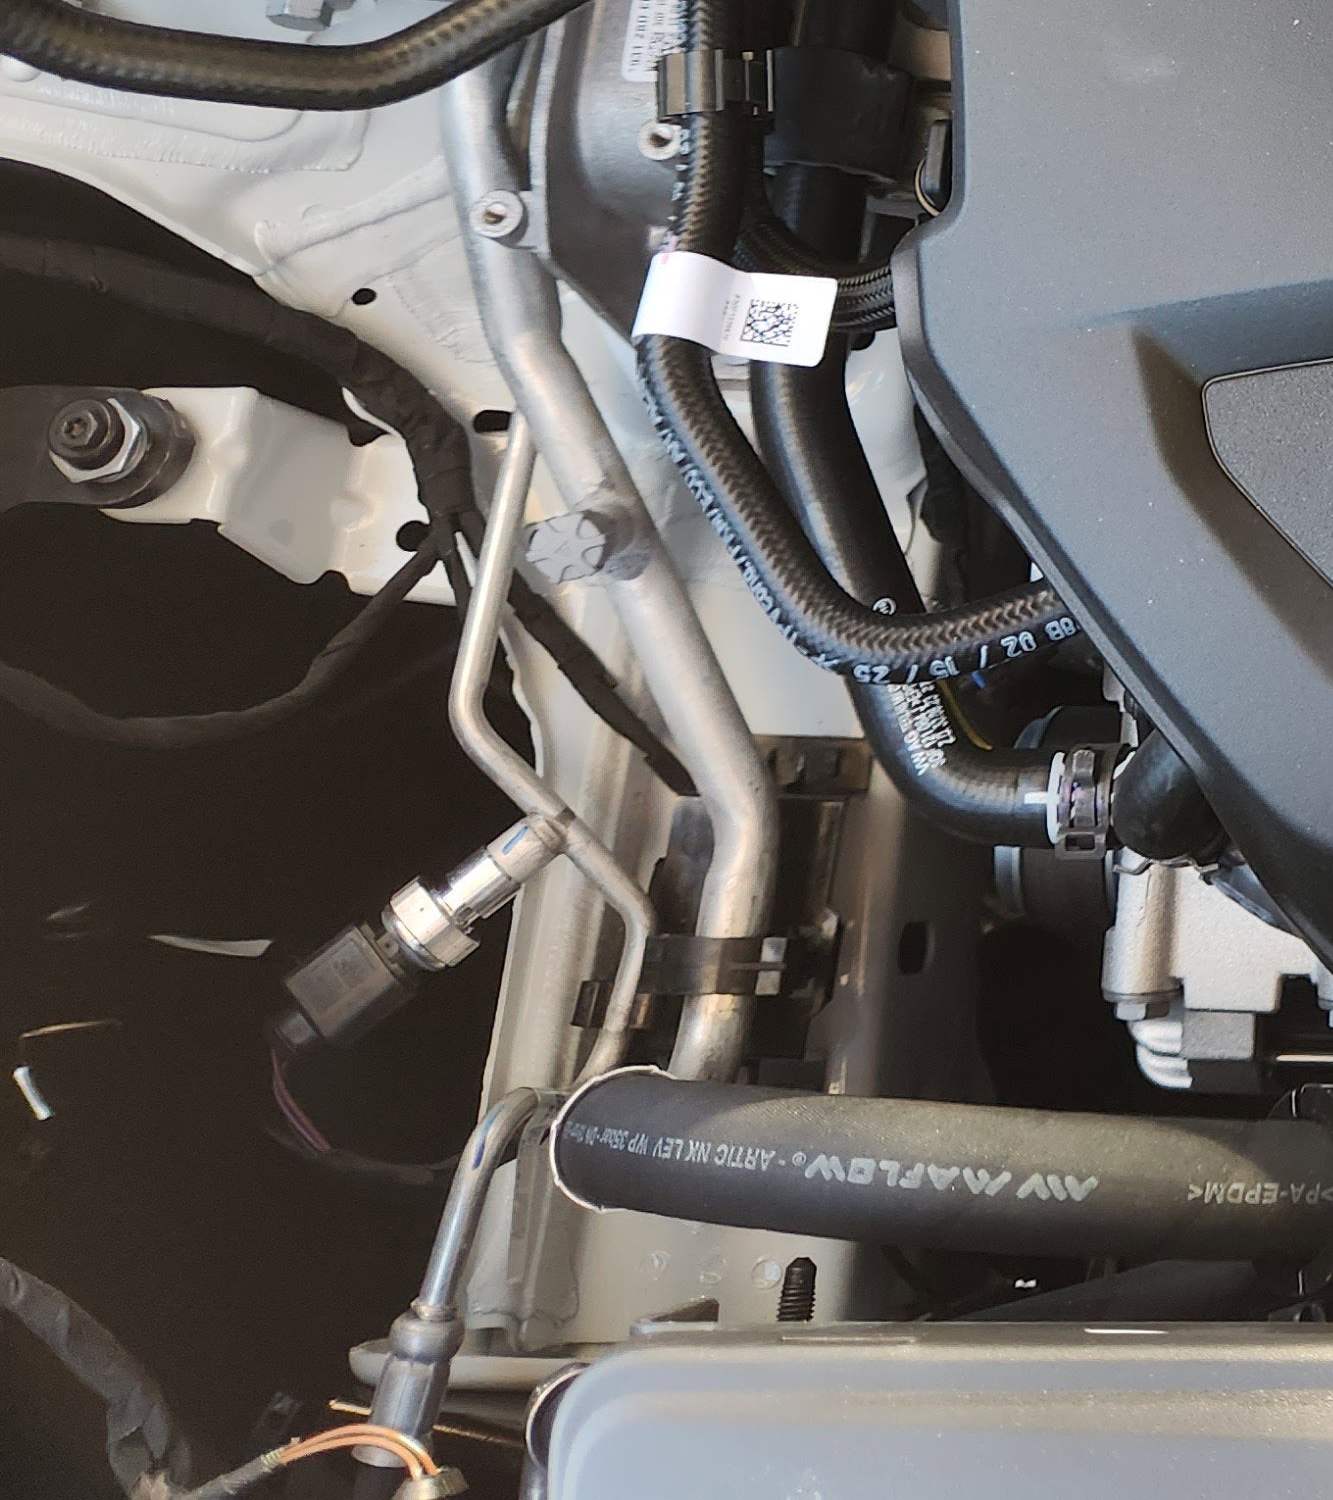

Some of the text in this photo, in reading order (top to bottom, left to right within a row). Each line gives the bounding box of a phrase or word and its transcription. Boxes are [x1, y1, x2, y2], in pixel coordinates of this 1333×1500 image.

[1044, 616, 1081, 642] 8B
[853, 664, 891, 685] 25
[626, 1132, 649, 1156] WP
[652, 1136, 685, 1160] LEV
[684, 1139, 712, 1164] NK
[714, 1143, 776, 1171] ARTIC
